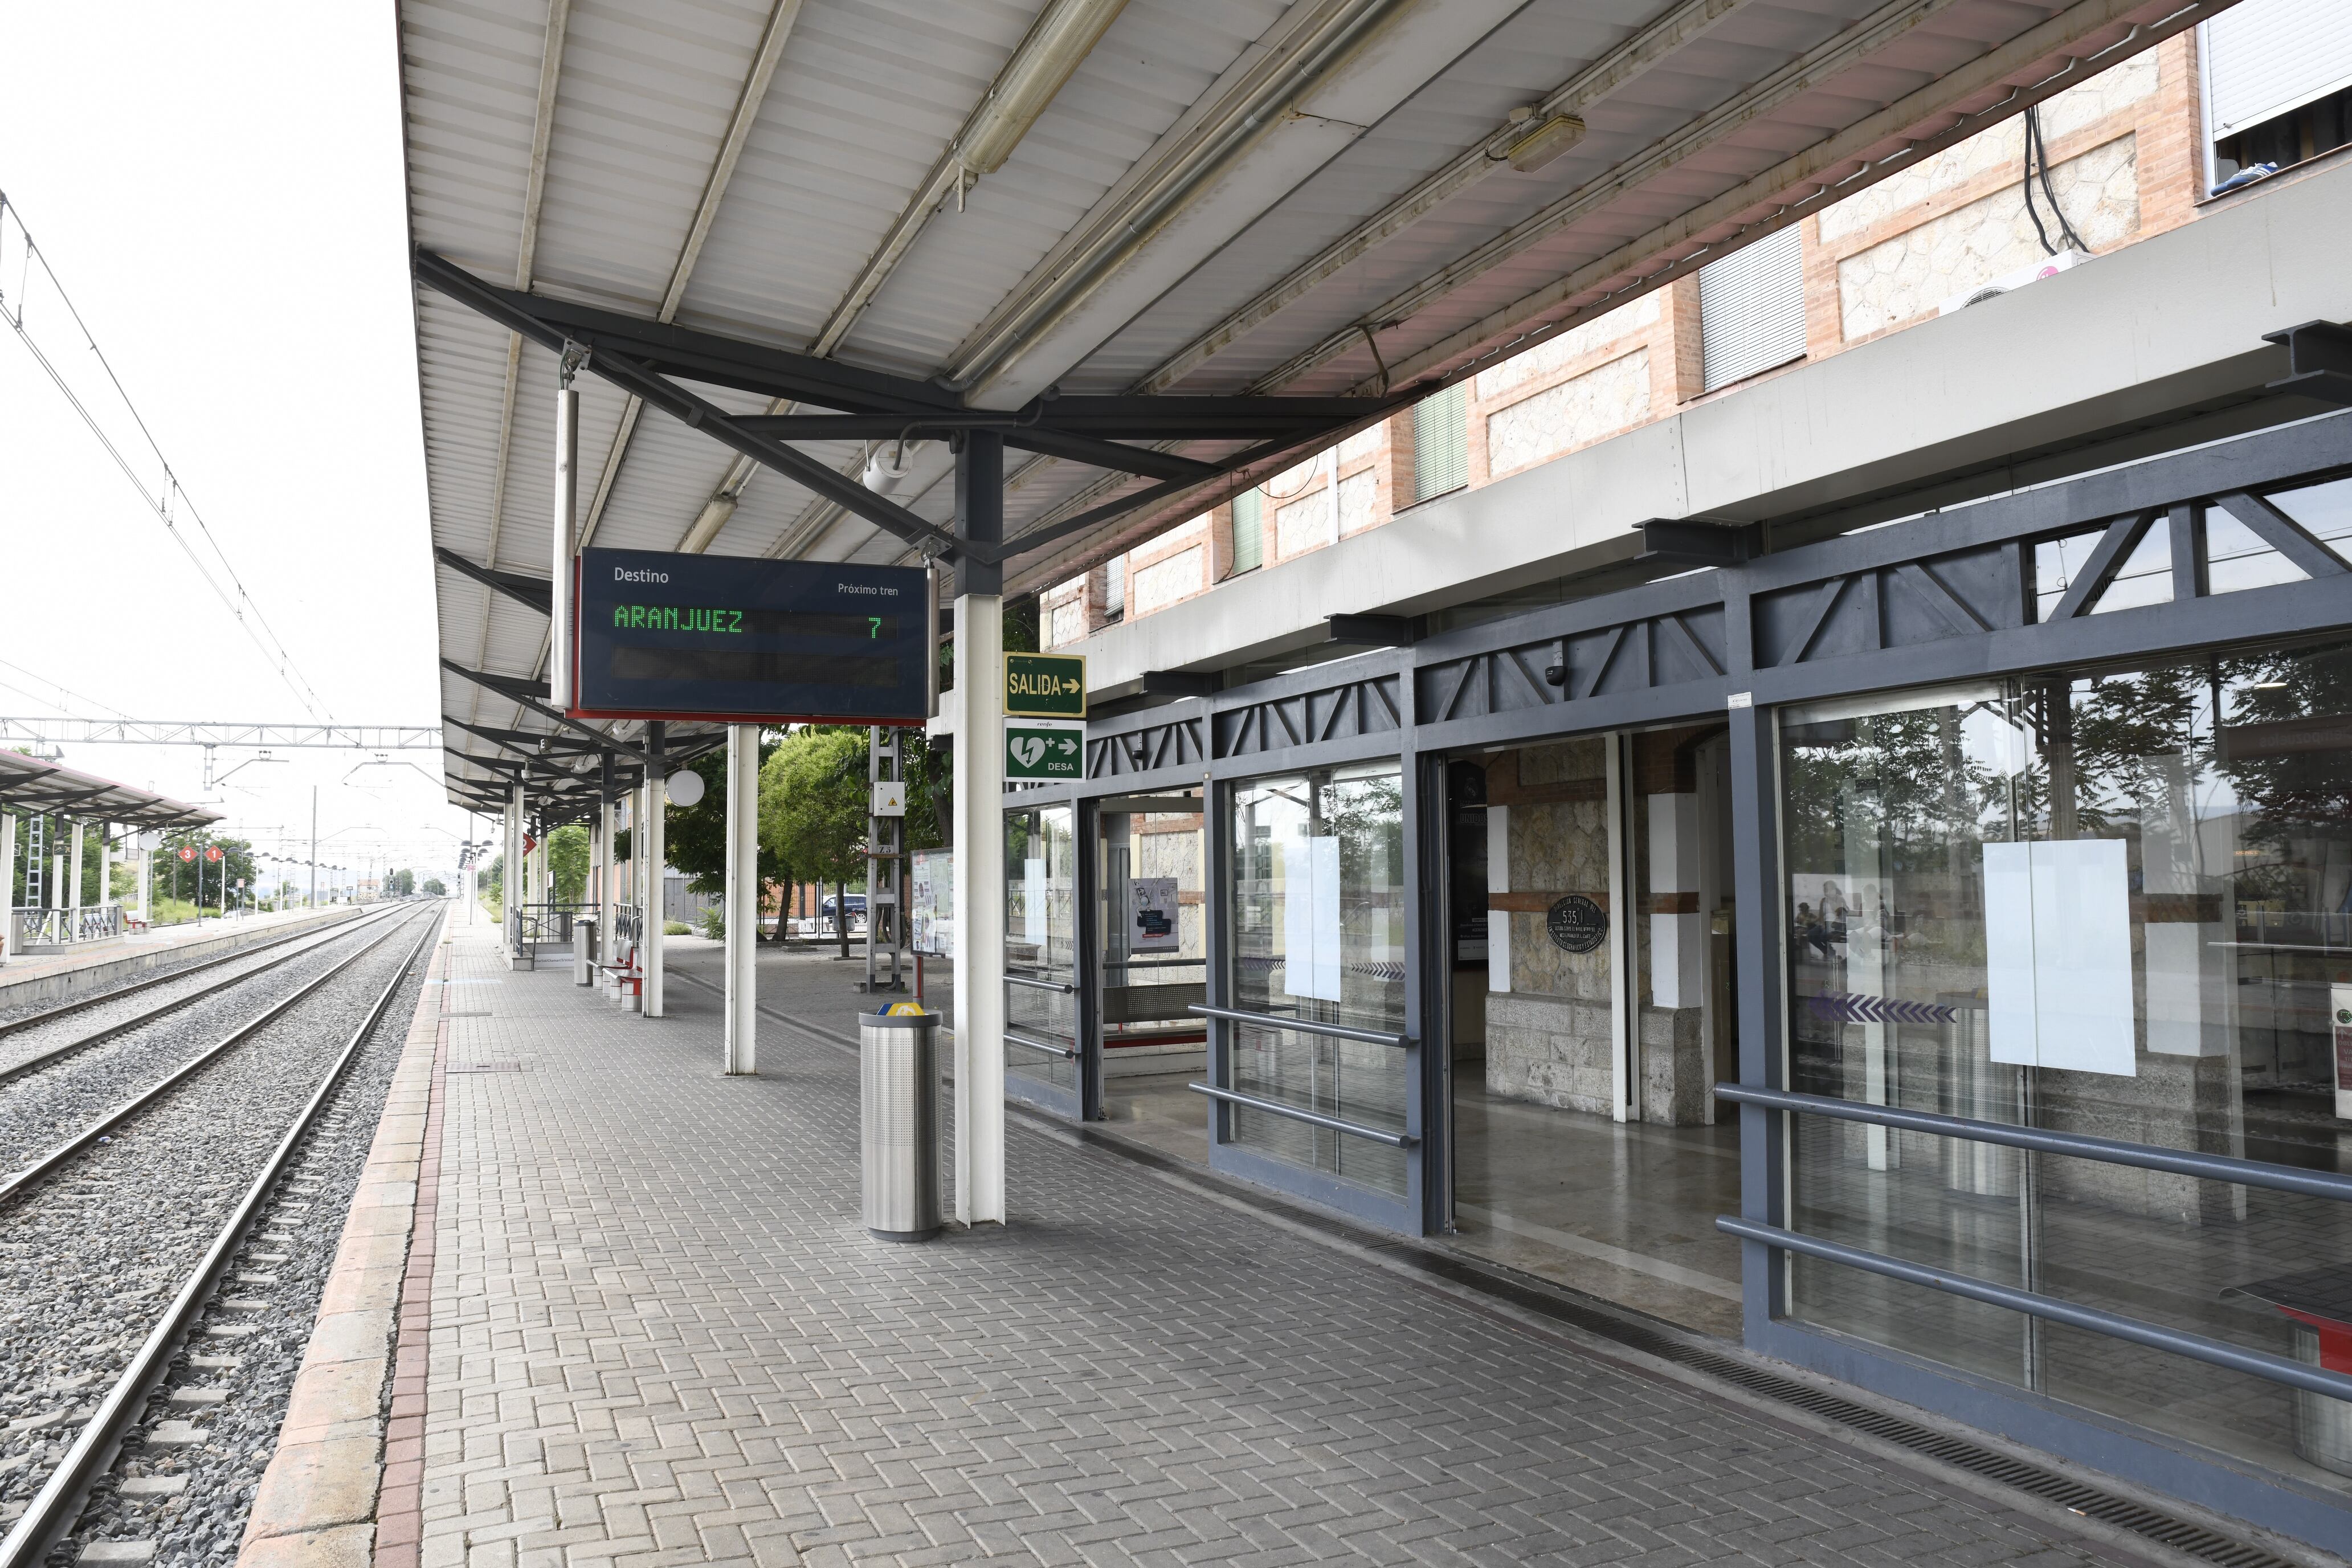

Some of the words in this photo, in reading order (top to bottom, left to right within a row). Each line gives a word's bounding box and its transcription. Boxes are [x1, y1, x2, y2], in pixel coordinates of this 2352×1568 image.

[614, 567, 669, 583] Destino
[838, 582, 877, 595] Próximo
[880, 585, 899, 596] tren
[614, 605, 742, 633] ARANJUEZ
[868, 617, 881, 639] 7
[1009, 672, 1061, 696] SALIDA
[1048, 762, 1073, 771] DESA
[185, 850, 191, 858] 3
[211, 850, 216, 858] 1
[1573, 897, 1589, 908] GENERAL
[1548, 926, 1563, 946] INSTITUTO
